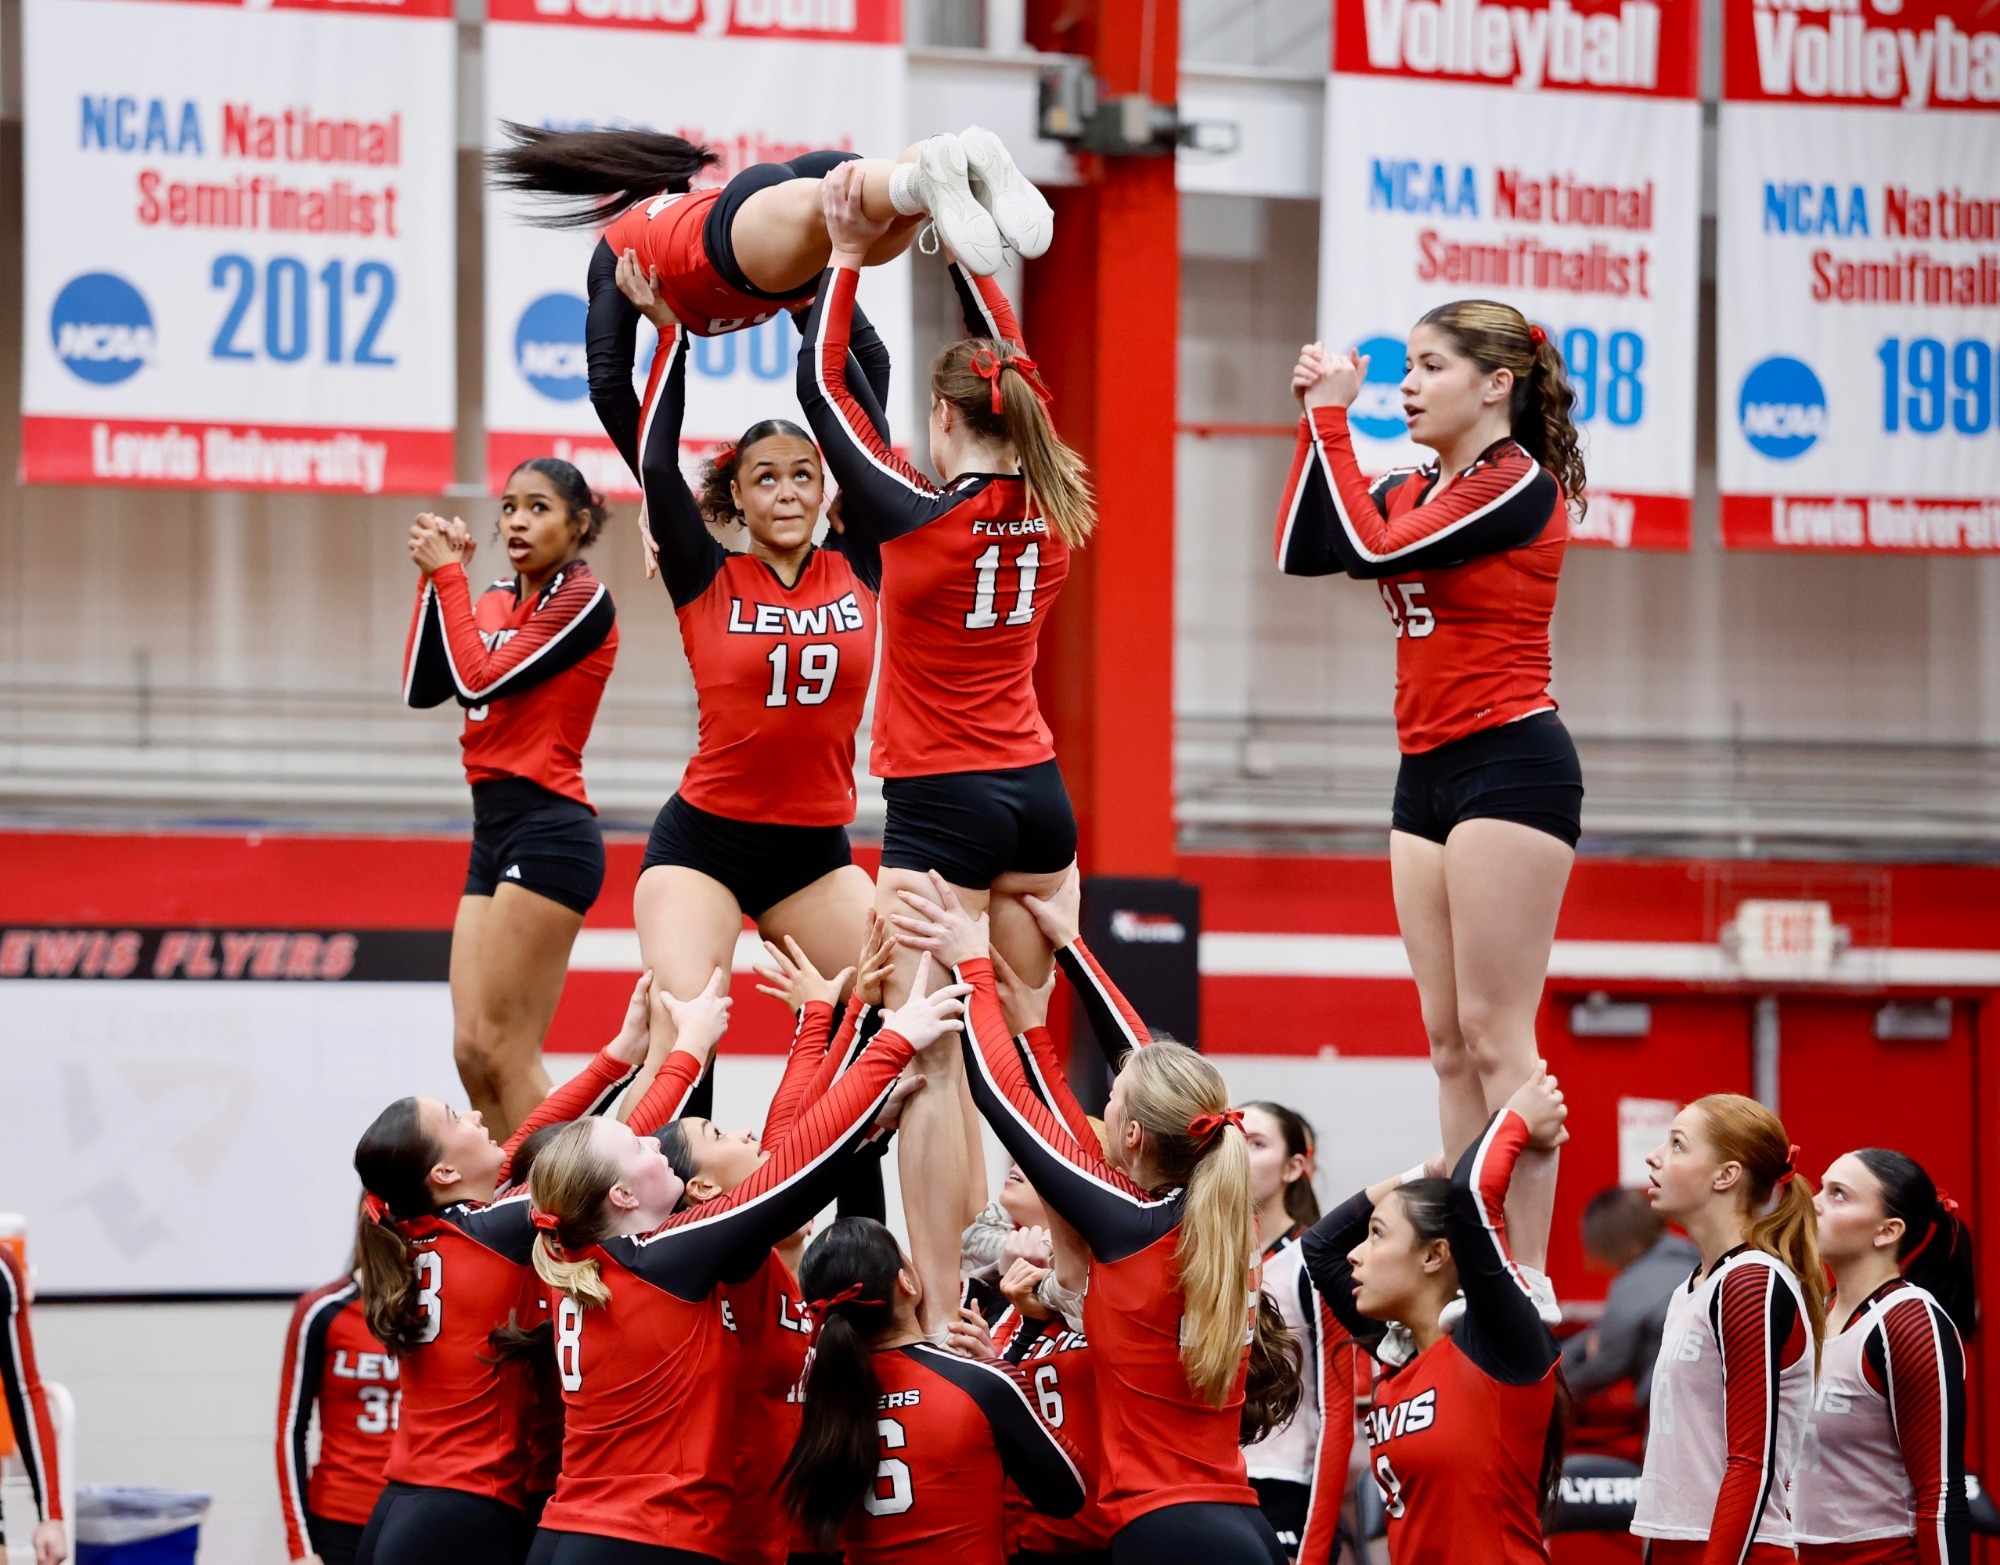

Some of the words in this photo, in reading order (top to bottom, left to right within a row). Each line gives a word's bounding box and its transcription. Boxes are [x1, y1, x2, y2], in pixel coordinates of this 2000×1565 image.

[1364, 0, 1661, 92] Volleyball
[80, 95, 204, 154] NCAA
[221, 103, 401, 165] National
[137, 170, 399, 238] Semifinalist
[1370, 158, 1479, 217] NCAA
[1495, 167, 1655, 232] National
[1763, 181, 1869, 237] NCAA
[1418, 229, 1652, 298] Semifinalist
[211, 254, 397, 366] 2012
[1563, 328, 1644, 425] 98
[1877, 337, 2000, 434] 199
[92, 423, 199, 480] Lewis
[203, 427, 388, 493] University
[972, 516, 1047, 537] FLYERS
[1771, 496, 1866, 546] Lewis
[727, 591, 864, 636] LEWIS
[965, 541, 1040, 629] 11
[765, 642, 839, 708] 19
[153, 932, 358, 980] FLYERS
[876, 1388, 920, 1410] ERS
[863, 1417, 914, 1517] 6
